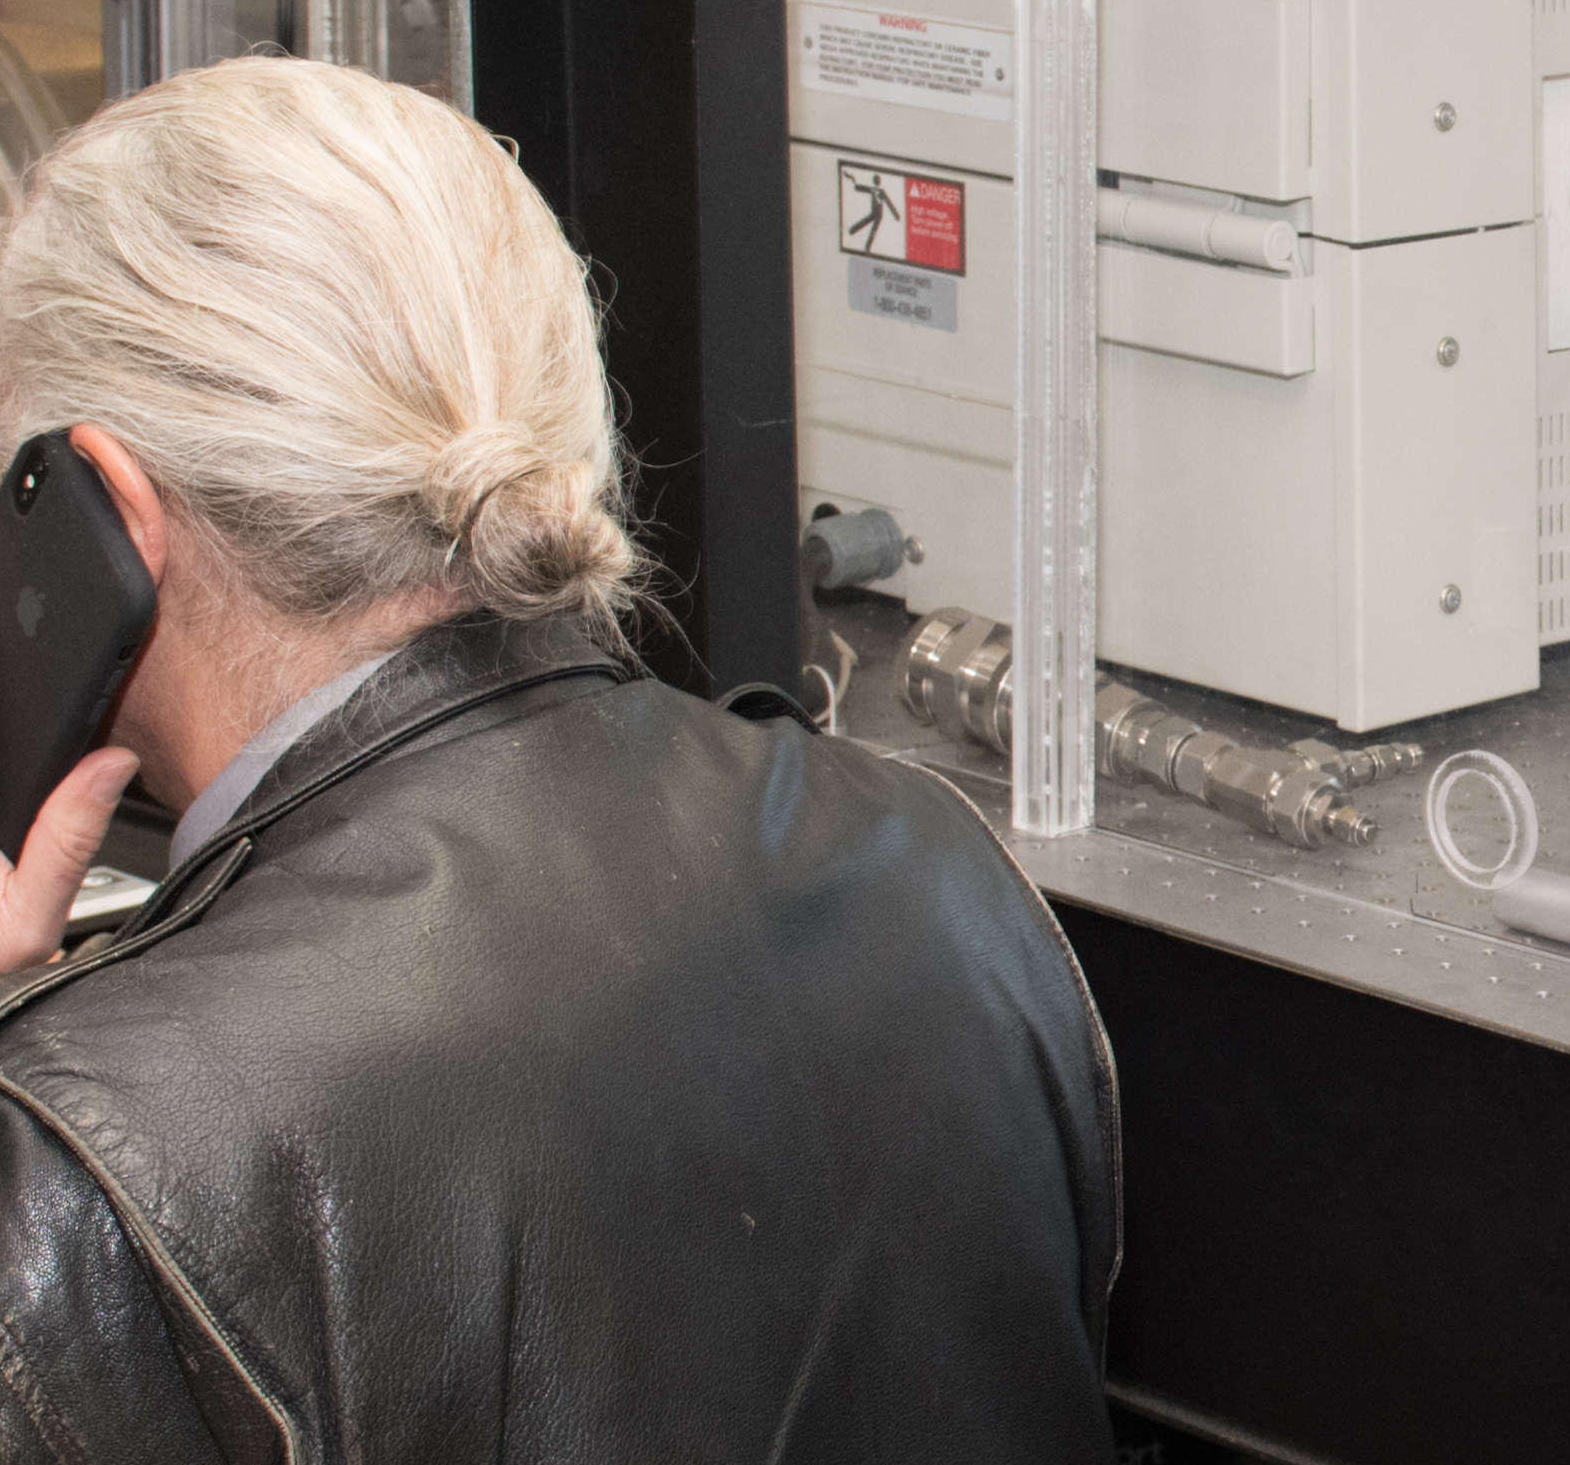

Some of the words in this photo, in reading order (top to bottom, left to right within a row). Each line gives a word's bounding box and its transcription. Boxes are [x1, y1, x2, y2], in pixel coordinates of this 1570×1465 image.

[878, 14, 927, 33] WARNING
[820, 33, 837, 43] WHICH
[855, 39, 872, 49] CAUSE
[875, 43, 895, 52] SEVERE
[898, 47, 938, 59] RESPIRATORY
[834, 26, 859, 36] PRODUCT
[862, 31, 891, 41] CONTAINS
[893, 36, 932, 48] REFRACTORY
[944, 45, 971, 55] CERAMIC
[973, 49, 990, 59] FIBER
[893, 67, 931, 78] PROTECTION
[920, 183, 960, 204] DANGER
